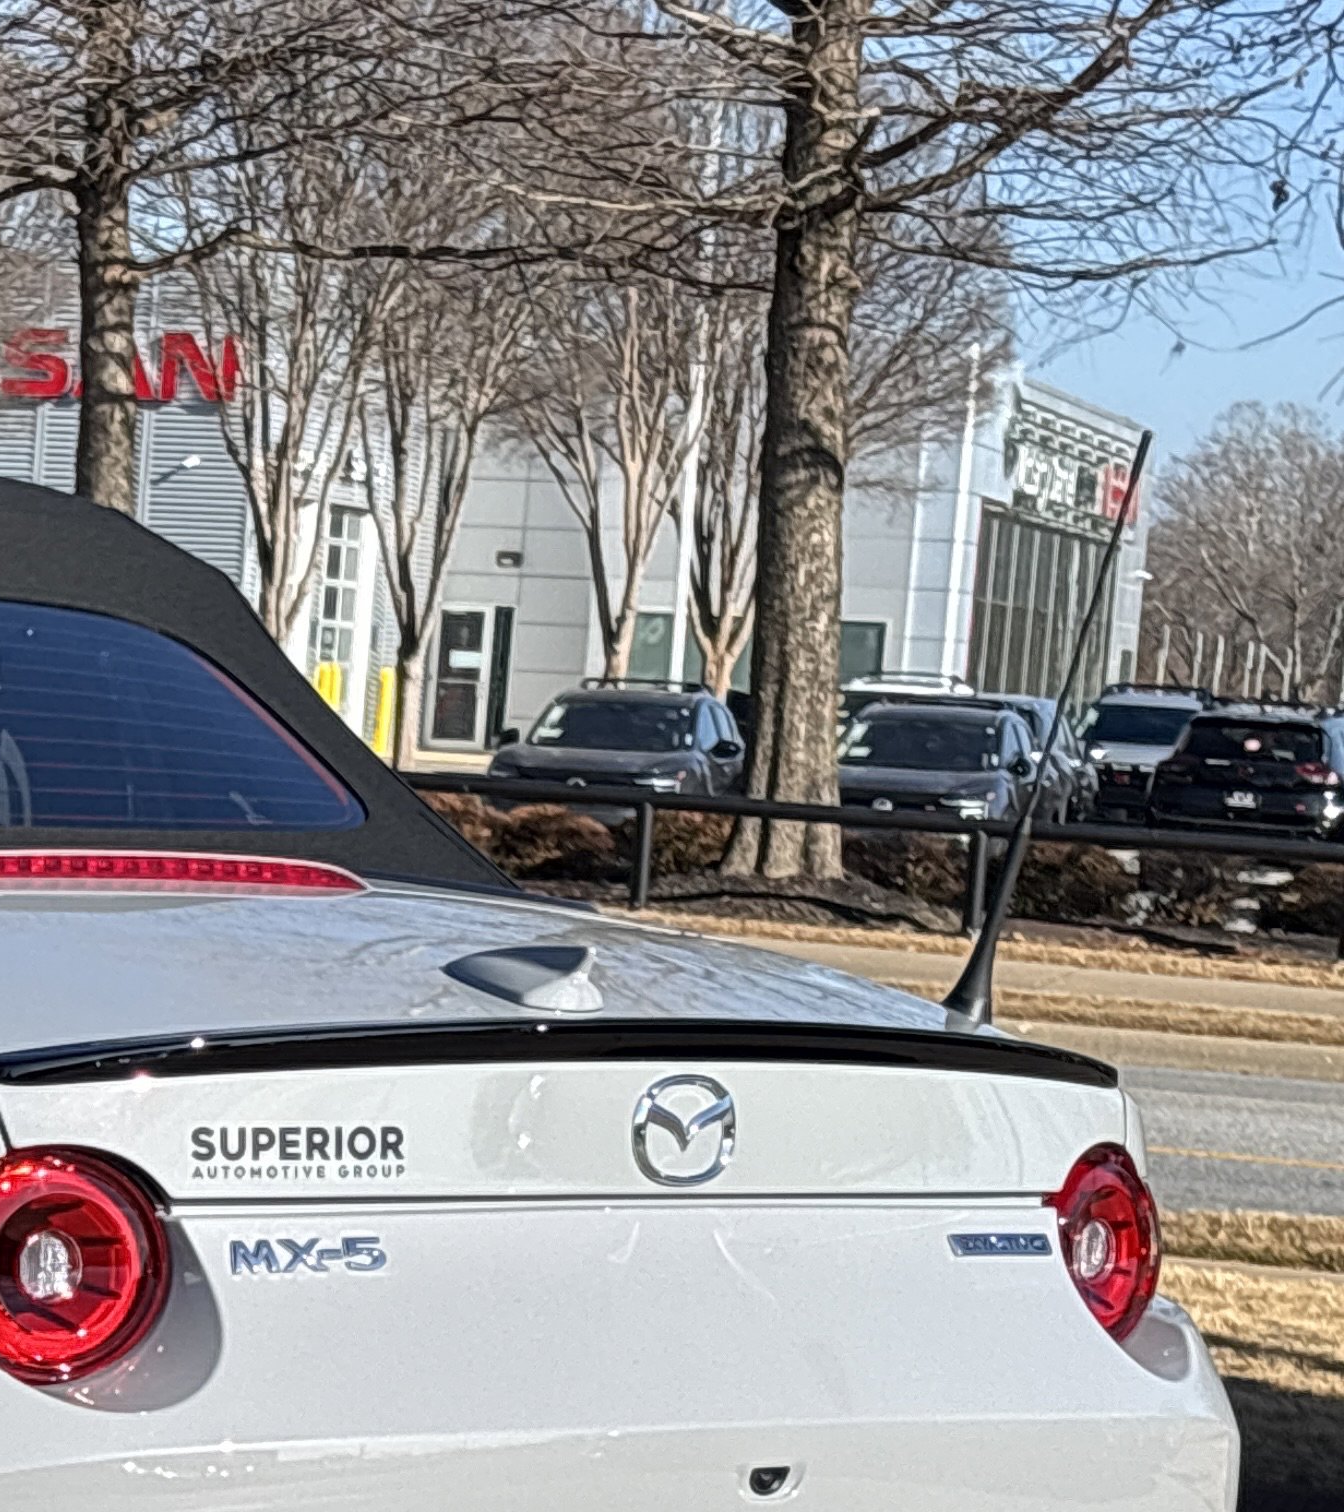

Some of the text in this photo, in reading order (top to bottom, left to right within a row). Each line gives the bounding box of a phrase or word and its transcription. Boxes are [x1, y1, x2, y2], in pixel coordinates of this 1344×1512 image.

[191, 1126, 405, 1161] SUPERIOR
[191, 1164, 406, 1180] AUTOMOTIVE GROUP
[228, 1236, 388, 1275] MX-5
